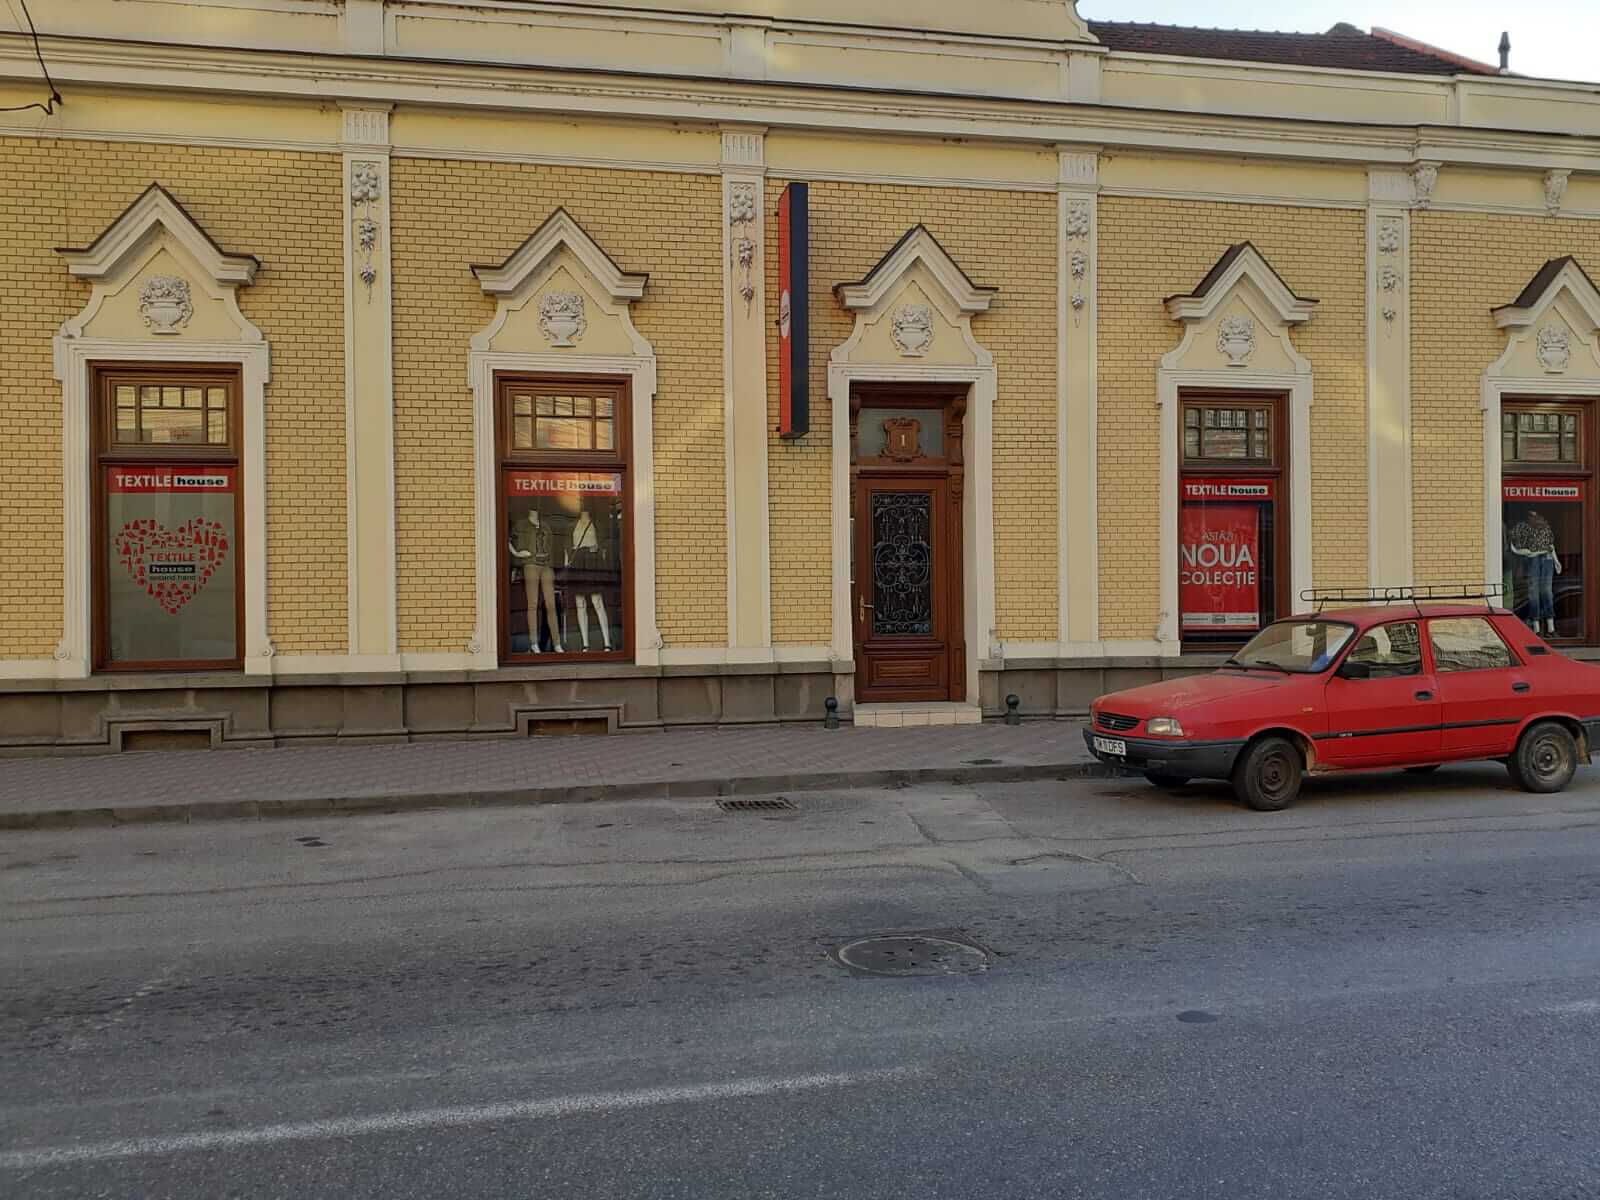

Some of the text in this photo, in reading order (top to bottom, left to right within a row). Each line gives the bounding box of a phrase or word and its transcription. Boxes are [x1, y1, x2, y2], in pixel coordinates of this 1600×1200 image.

[115, 475, 225, 487] TEXTILE house
[514, 479, 612, 490] TEXTILE house
[1185, 485, 1266, 496] TEXTILE house
[1504, 487, 1576, 496] TEXTILE house
[150, 552, 194, 561] TEXTILE
[1181, 543, 1255, 568] NOUA
[152, 565, 193, 573] house
